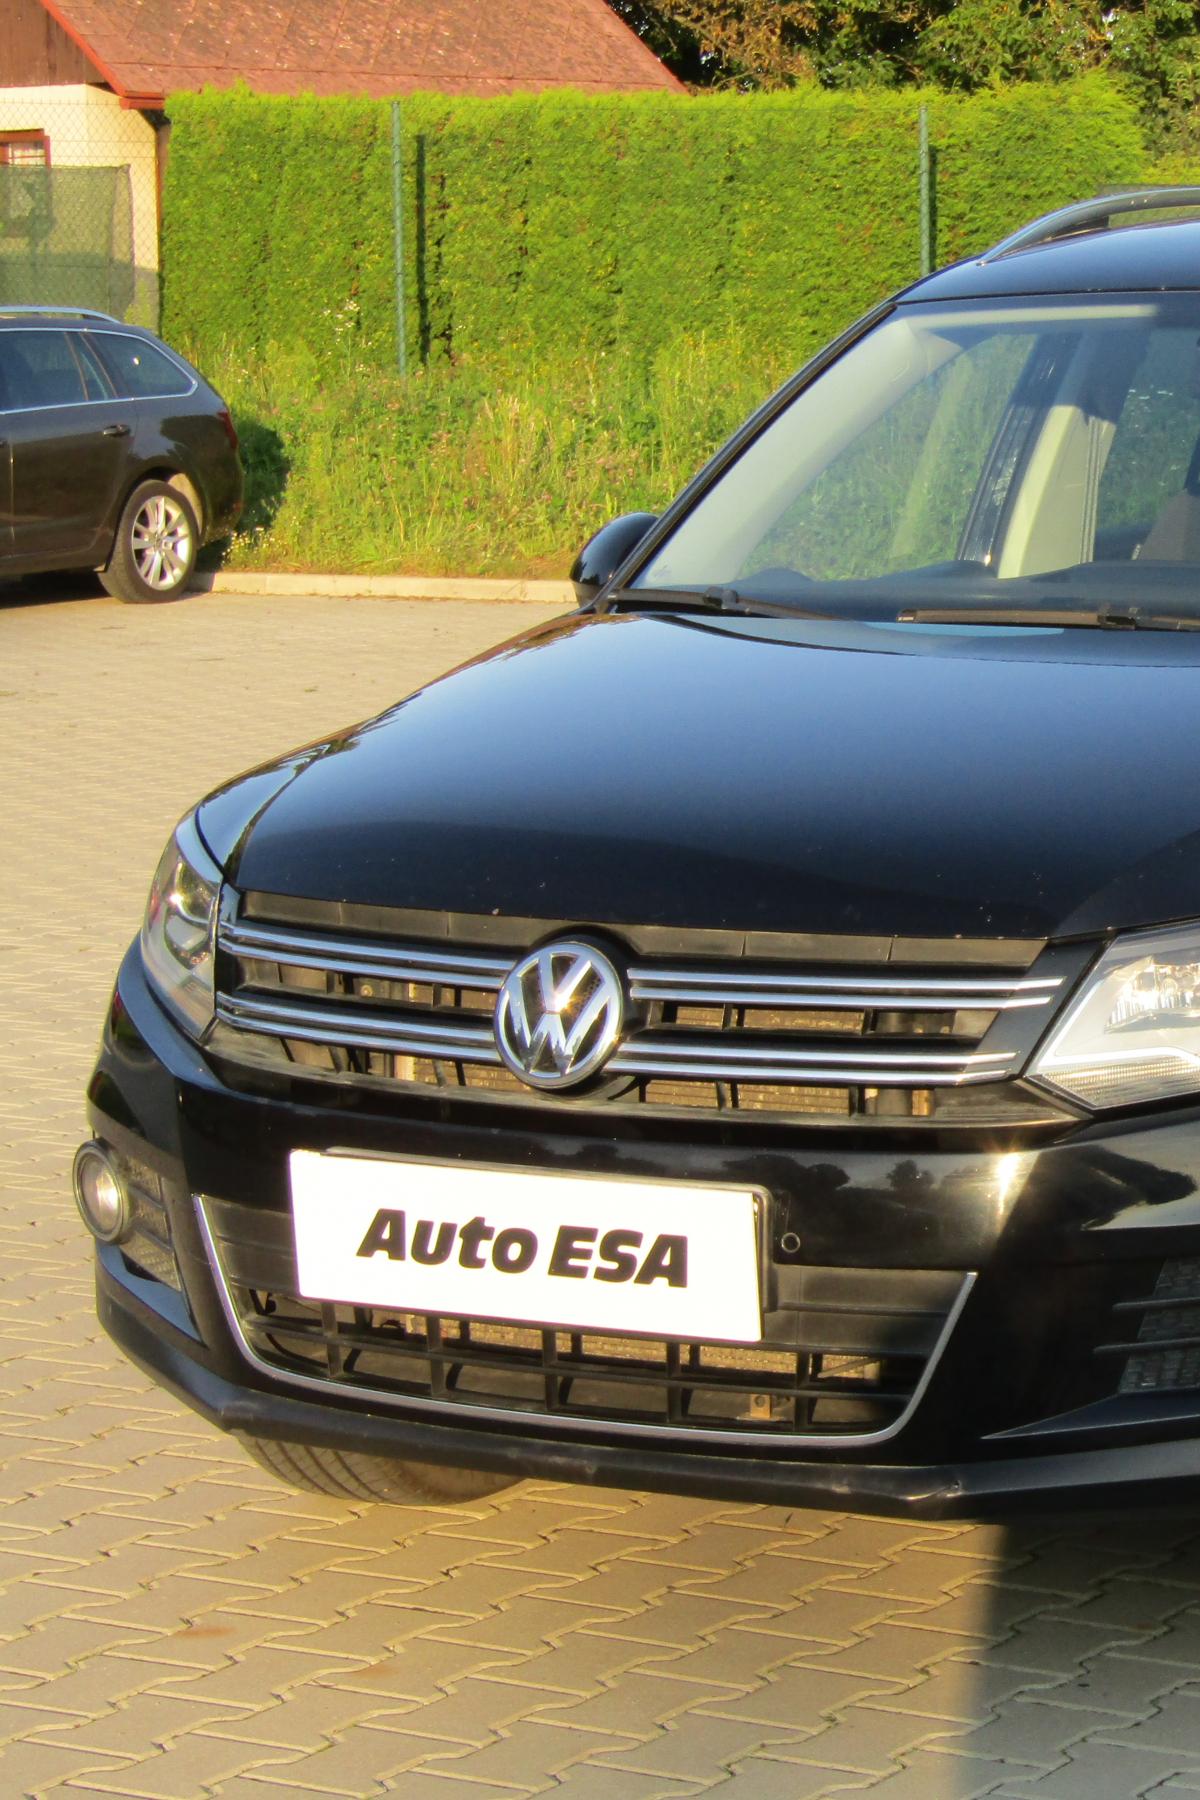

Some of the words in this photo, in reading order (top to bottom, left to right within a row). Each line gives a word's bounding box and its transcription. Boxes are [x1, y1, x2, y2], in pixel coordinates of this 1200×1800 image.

[502, 945, 616, 1083] VW
[357, 1209, 537, 1273] Auto
[548, 1226, 687, 1288] ESA
